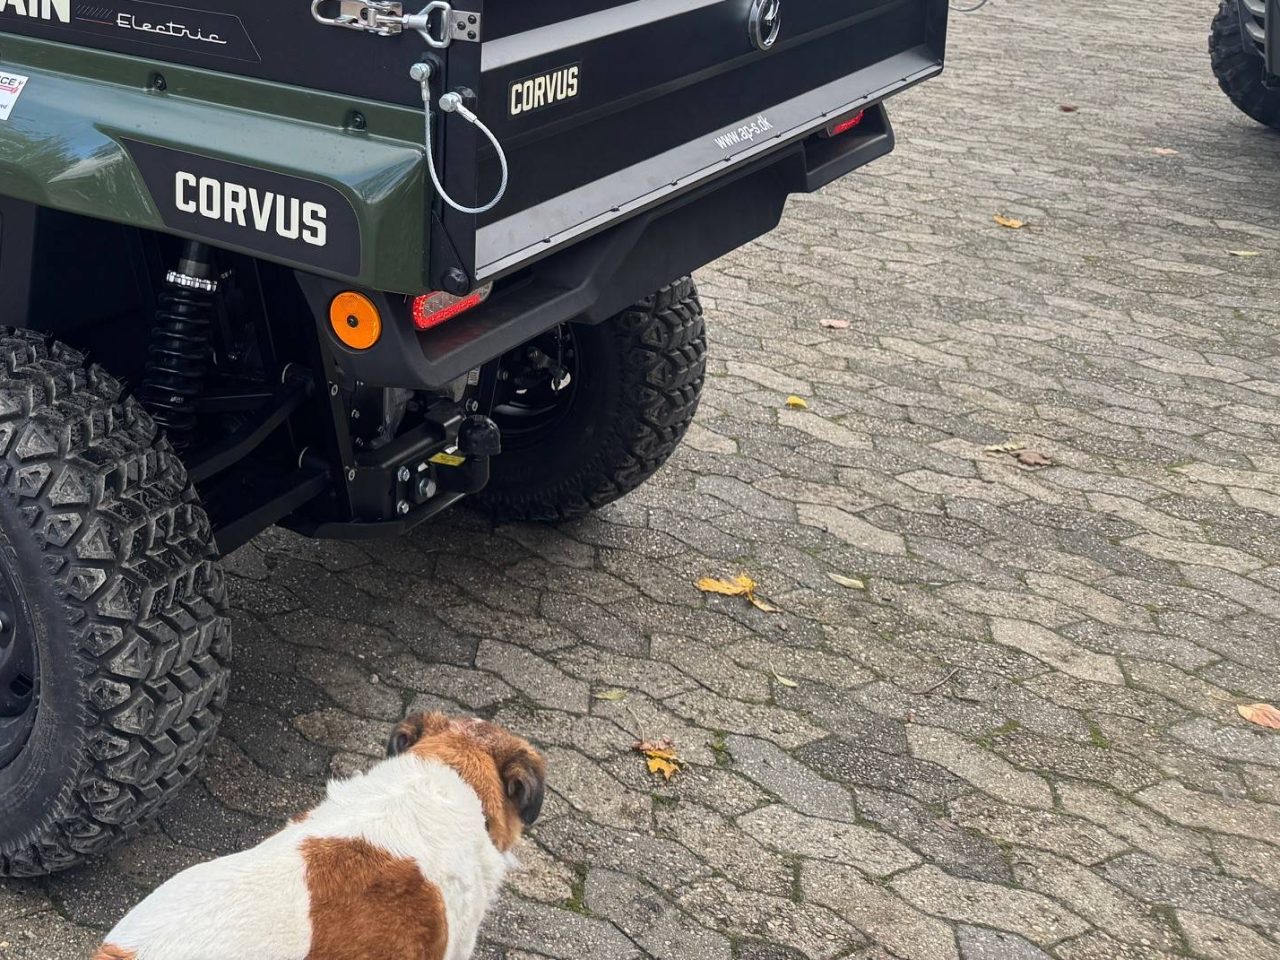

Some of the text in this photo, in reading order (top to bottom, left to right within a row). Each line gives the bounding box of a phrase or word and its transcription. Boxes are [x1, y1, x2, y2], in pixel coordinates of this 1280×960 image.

[116, 13, 227, 44] Electric
[511, 66, 579, 115] CORVUS
[714, 114, 773, 150] www.ap-s.dk
[175, 170, 327, 247] CORVUS
